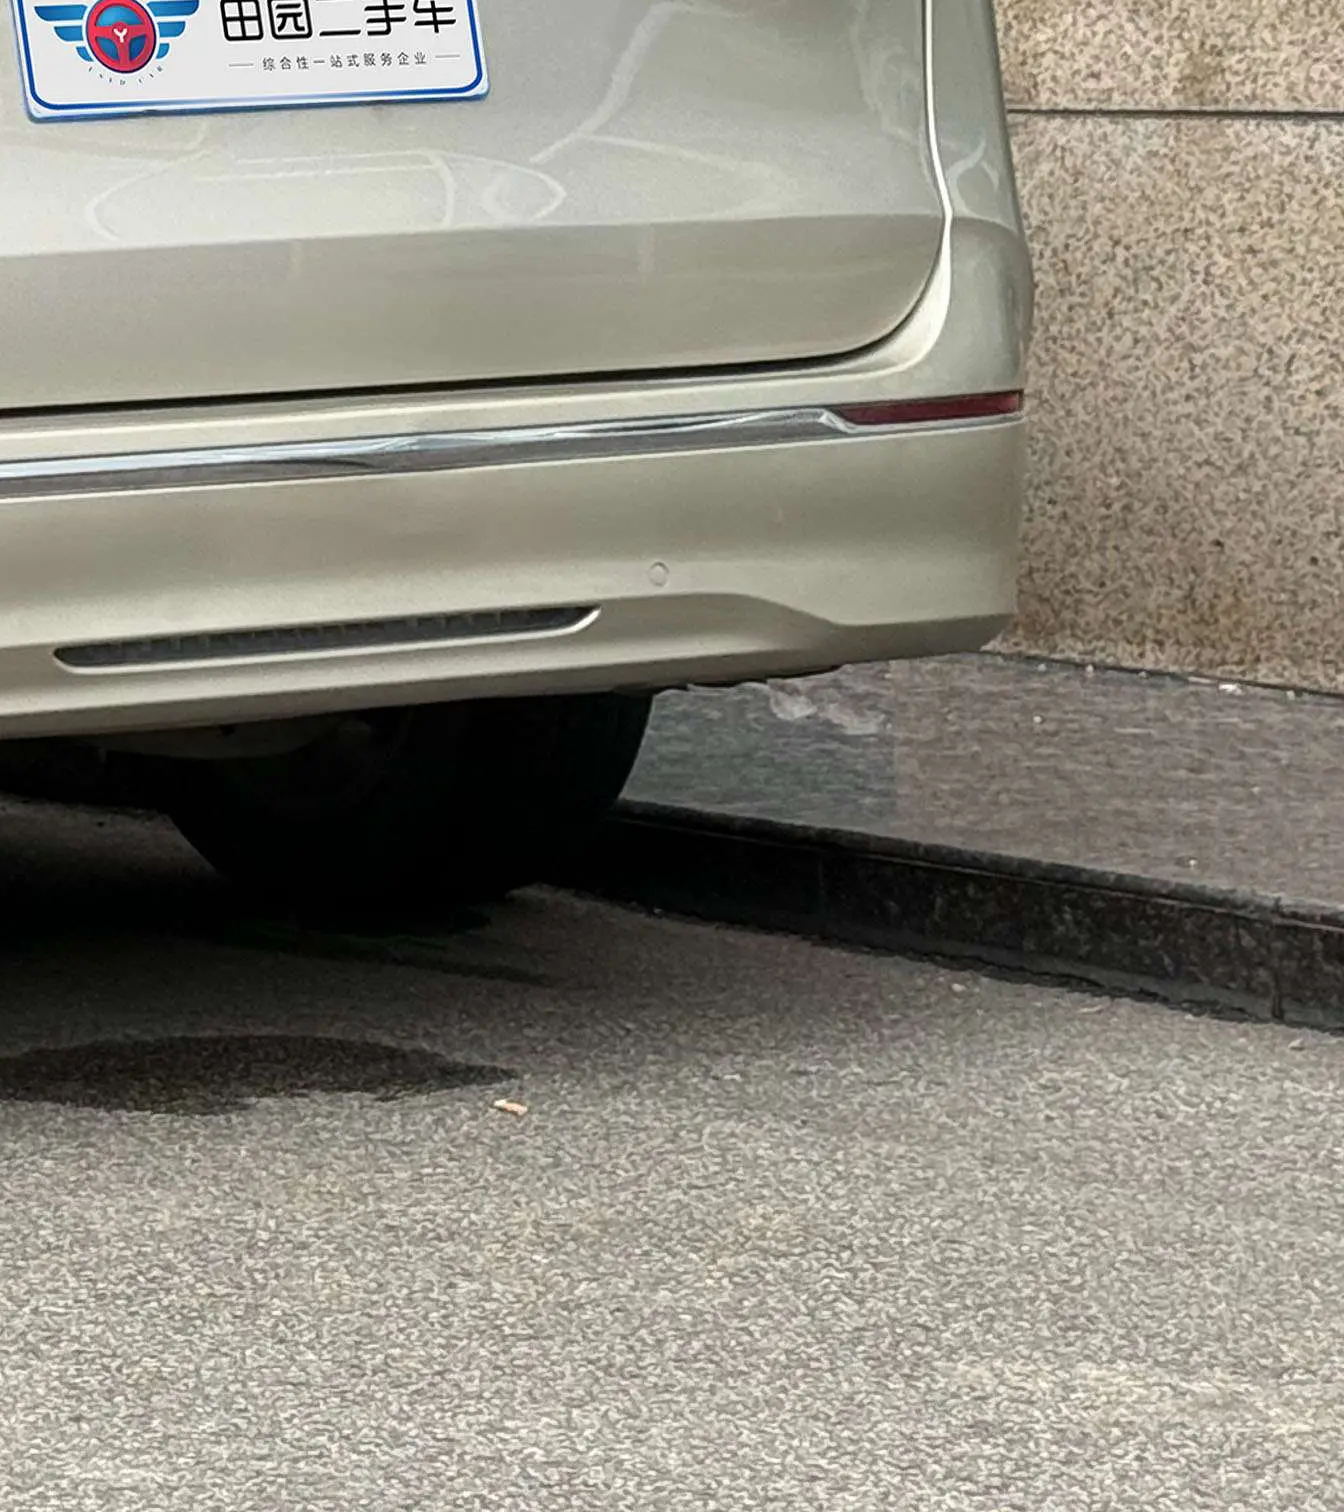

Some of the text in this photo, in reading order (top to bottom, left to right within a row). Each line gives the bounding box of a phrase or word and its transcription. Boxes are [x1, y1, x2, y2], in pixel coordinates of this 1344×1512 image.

[262, 51, 427, 71] 综合性一站式服务企业
